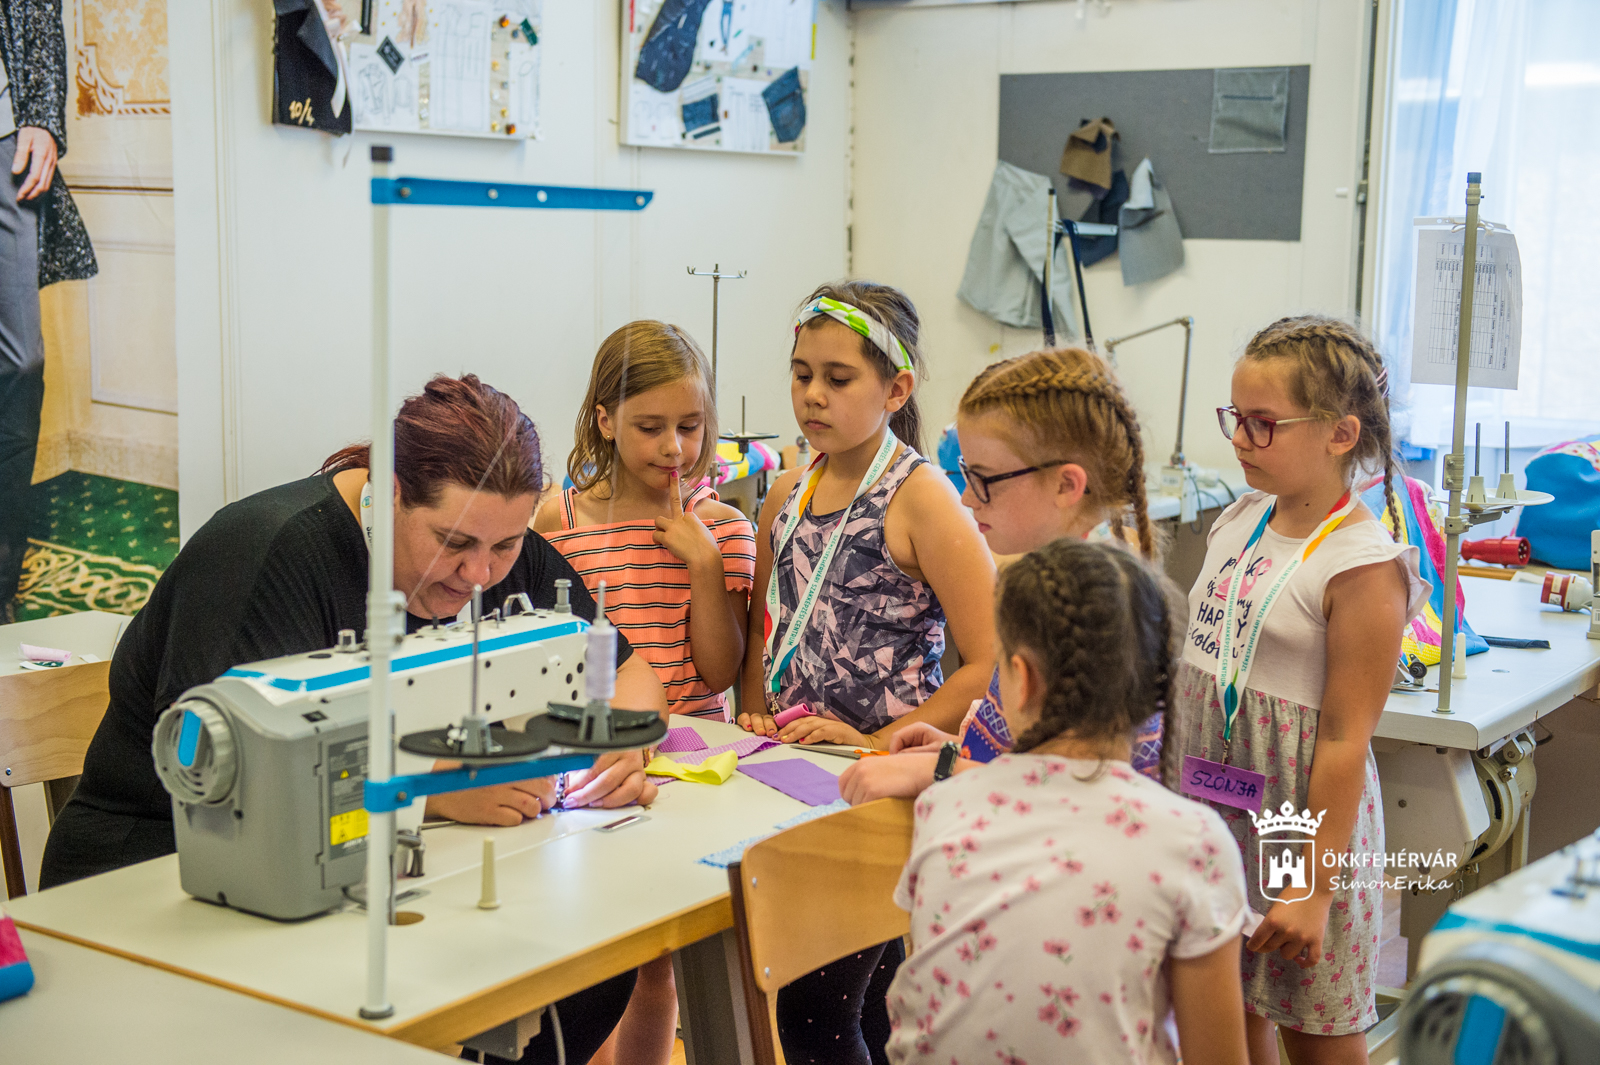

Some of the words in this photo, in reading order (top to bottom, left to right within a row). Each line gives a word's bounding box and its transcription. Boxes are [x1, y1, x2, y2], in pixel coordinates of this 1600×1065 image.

[865, 462, 882, 486] CENTRUM
[797, 583, 818, 621] SZAKKÉPZÉSI
[1240, 620, 1261, 673] SZÉKESFEHÉRVÁRI
[1257, 584, 1281, 619] SZAKKÉPZÉSI
[1278, 559, 1299, 583] CENTRUM
[786, 621, 803, 646] CENTRUM
[1196, 601, 1248, 639] HAPY
[1222, 618, 1233, 658] SZAKKÉPZÉSI
[1220, 658, 1229, 687] CENTRUM
[1190, 770, 1258, 798] SZONJA
